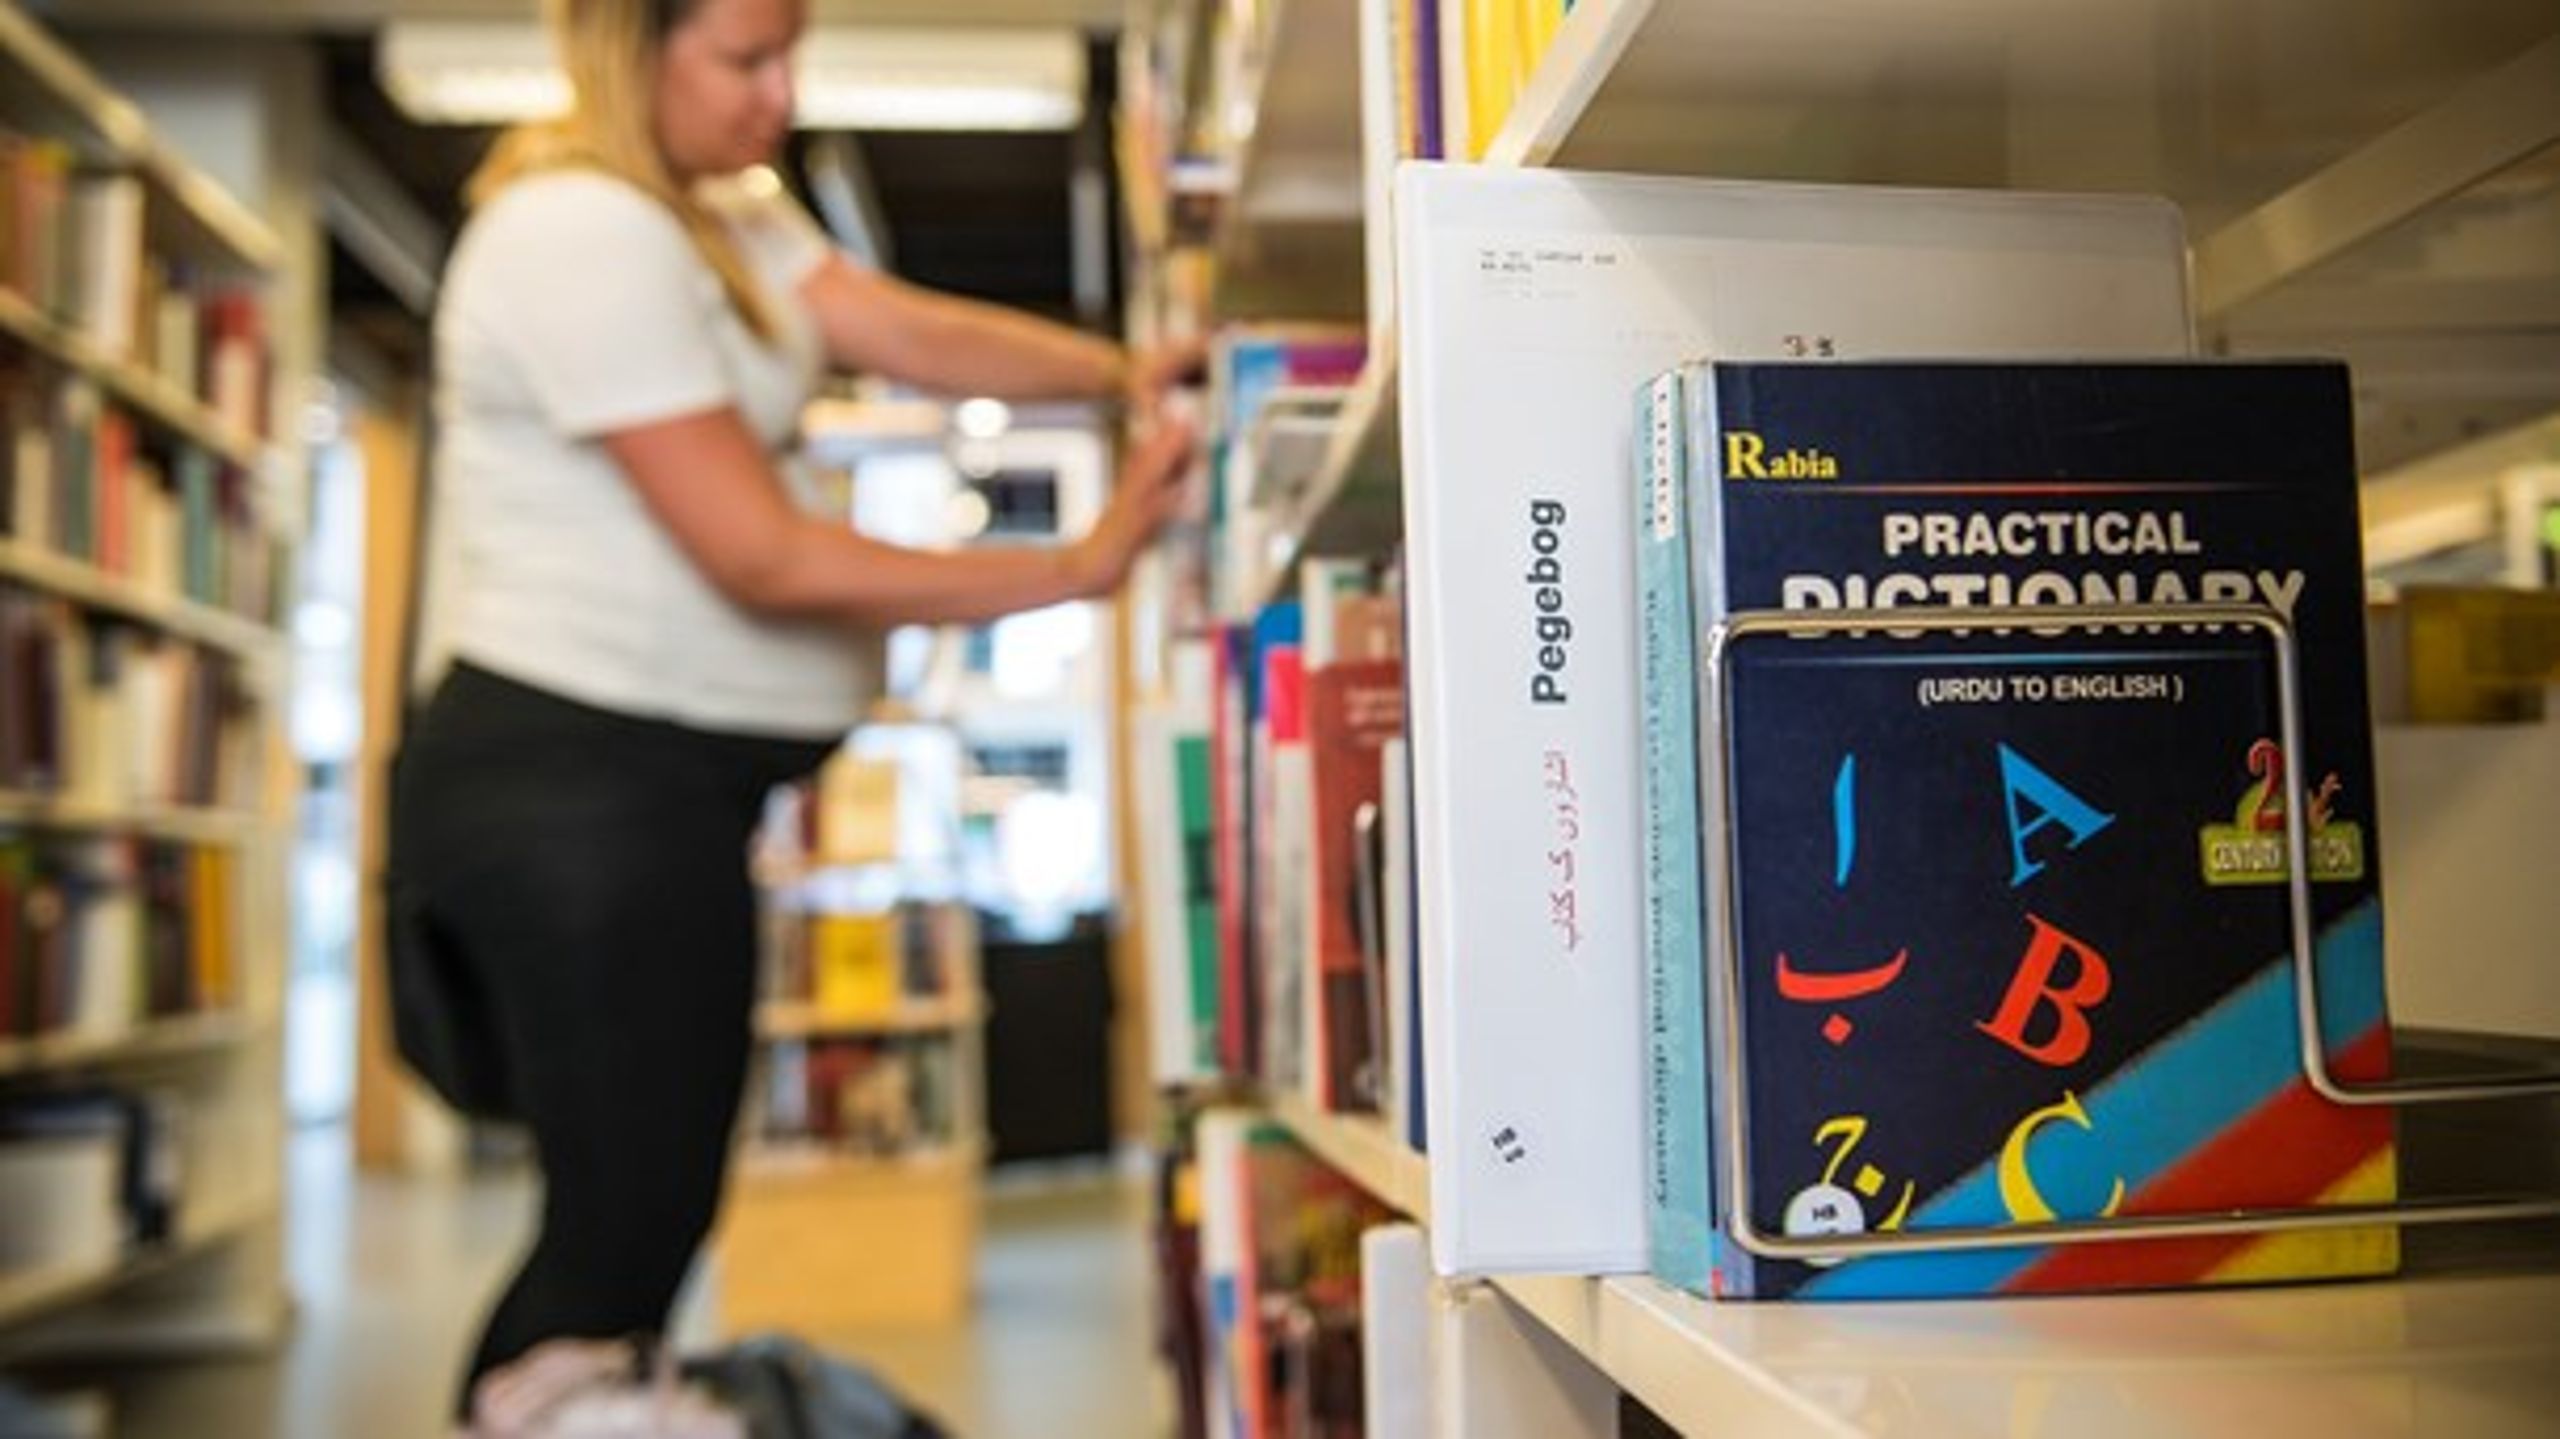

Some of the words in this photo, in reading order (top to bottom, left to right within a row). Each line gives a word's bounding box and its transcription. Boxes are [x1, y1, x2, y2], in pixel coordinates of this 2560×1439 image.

[1725, 431, 1838, 479] Rabia
[1883, 512, 2201, 557] PRACTICAL
[1527, 500, 1571, 704] Pegebog
[1782, 570, 2305, 638] DICTIONARY
[1918, 678, 2003, 706] (URDU
[2010, 676, 2048, 700] TO
[1999, 745, 2115, 886] A
[1776, 948, 1908, 1044] ب
[1975, 912, 2111, 1067] B
[1998, 1089, 2124, 1227] C
